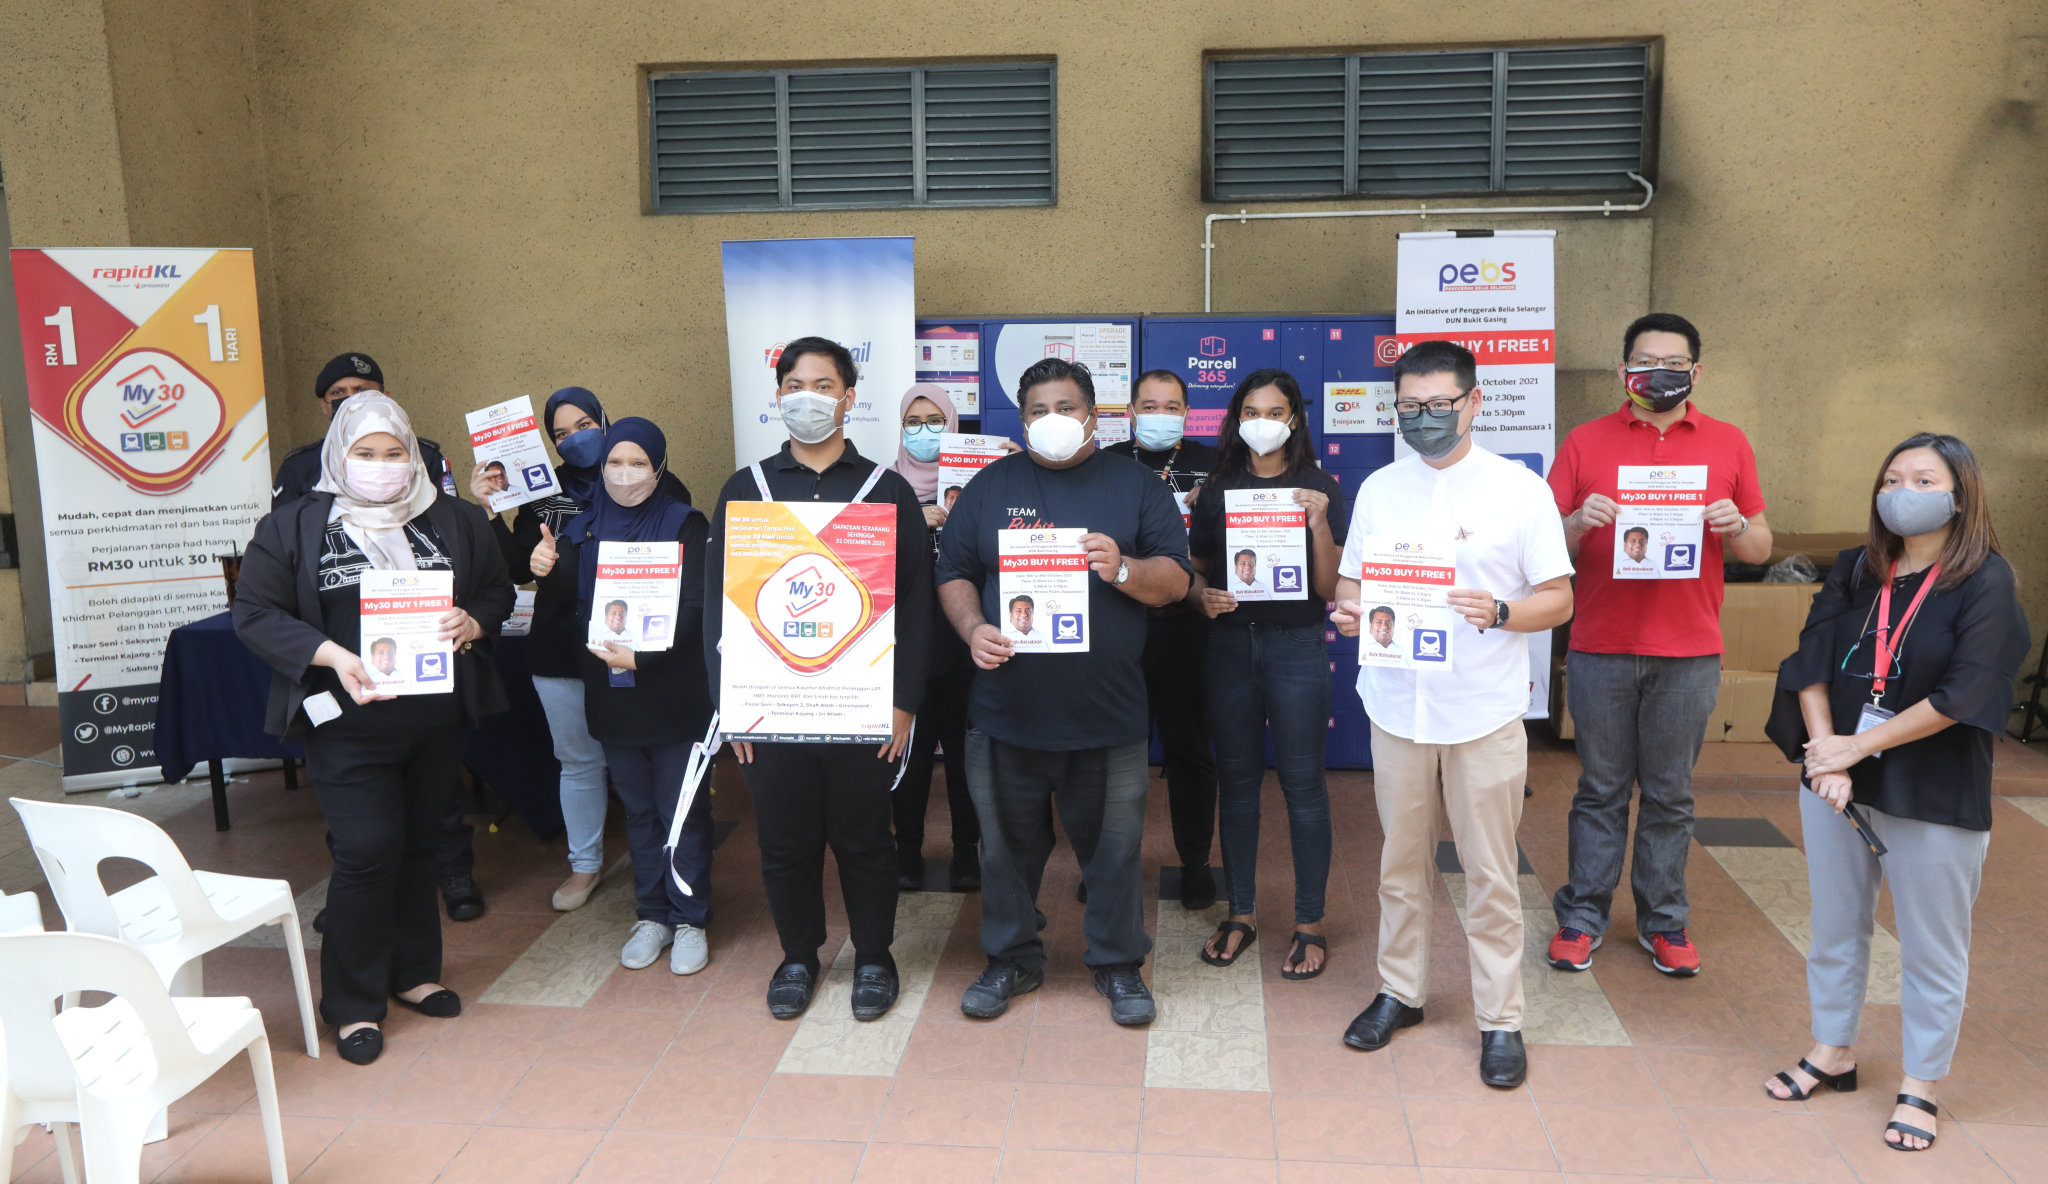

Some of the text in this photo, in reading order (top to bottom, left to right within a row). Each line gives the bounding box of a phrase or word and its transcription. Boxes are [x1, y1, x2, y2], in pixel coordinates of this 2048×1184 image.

[92, 264, 182, 282] rapidKL
[1438, 258, 1516, 292] pebs
[1406, 308, 1416, 316] An
[1416, 307, 1449, 315] initiative
[1450, 306, 1458, 314] of
[1459, 306, 1496, 316] Penggerak
[1516, 305, 1546, 314] Selangor
[1464, 316, 1482, 324] Bukit
[1484, 316, 1508, 324] Gasing
[44, 306, 78, 366] 1
[193, 304, 224, 362] 1
[224, 328, 239, 362] HARI
[1486, 338, 1549, 352] 1 FREE 1
[44, 344, 58, 366] RM
[1188, 356, 1236, 370] Parcel
[1198, 370, 1226, 382] 365
[1482, 377, 1538, 386] October 2021
[123, 383, 185, 405] My30
[1482, 394, 1526, 404] to 2.30pm
[1494, 409, 1525, 420] 5.30pm
[474, 432, 492, 442] My30
[492, 427, 506, 436] BUY
[512, 421, 530, 430] FREE
[1471, 424, 1498, 432] Phileo
[1500, 424, 1546, 432] Damansara
[1621, 493, 1646, 502] My30
[58, 502, 260, 521] Mudah, cepat dan menjimatkan untuk
[1006, 507, 1036, 517] TEAM
[50, 517, 251, 536] semua perkhidmatan rel dan bas Rapid
[1230, 516, 1252, 524] My30
[91, 538, 235, 554] Perjalanan tanpa had hanya
[88, 558, 134, 572] RM30
[138, 555, 184, 569] untuk
[188, 554, 208, 564] 30
[1003, 559, 1029, 568] My30
[1366, 566, 1392, 576] My30
[1394, 568, 1413, 576] BUY
[1421, 570, 1445, 578] FREE
[789, 581, 835, 598] My30
[88, 591, 208, 608] Boleh didapati di semua
[364, 601, 390, 611] My30
[392, 601, 410, 609] BUY
[62, 613, 106, 624] Khidmat
[108, 608, 162, 621] Pelanggan
[164, 606, 185, 615] LRT,
[187, 604, 210, 613] MRT,
[116, 624, 136, 632] dan
[138, 623, 145, 631] 8
[147, 622, 166, 630] hab
[168, 620, 186, 629] bas
[72, 636, 161, 650] Pasar Seni Seksyen
[80, 654, 119, 664] Terminal
[120, 651, 150, 662] Kajang
[126, 664, 159, 674] Subang
